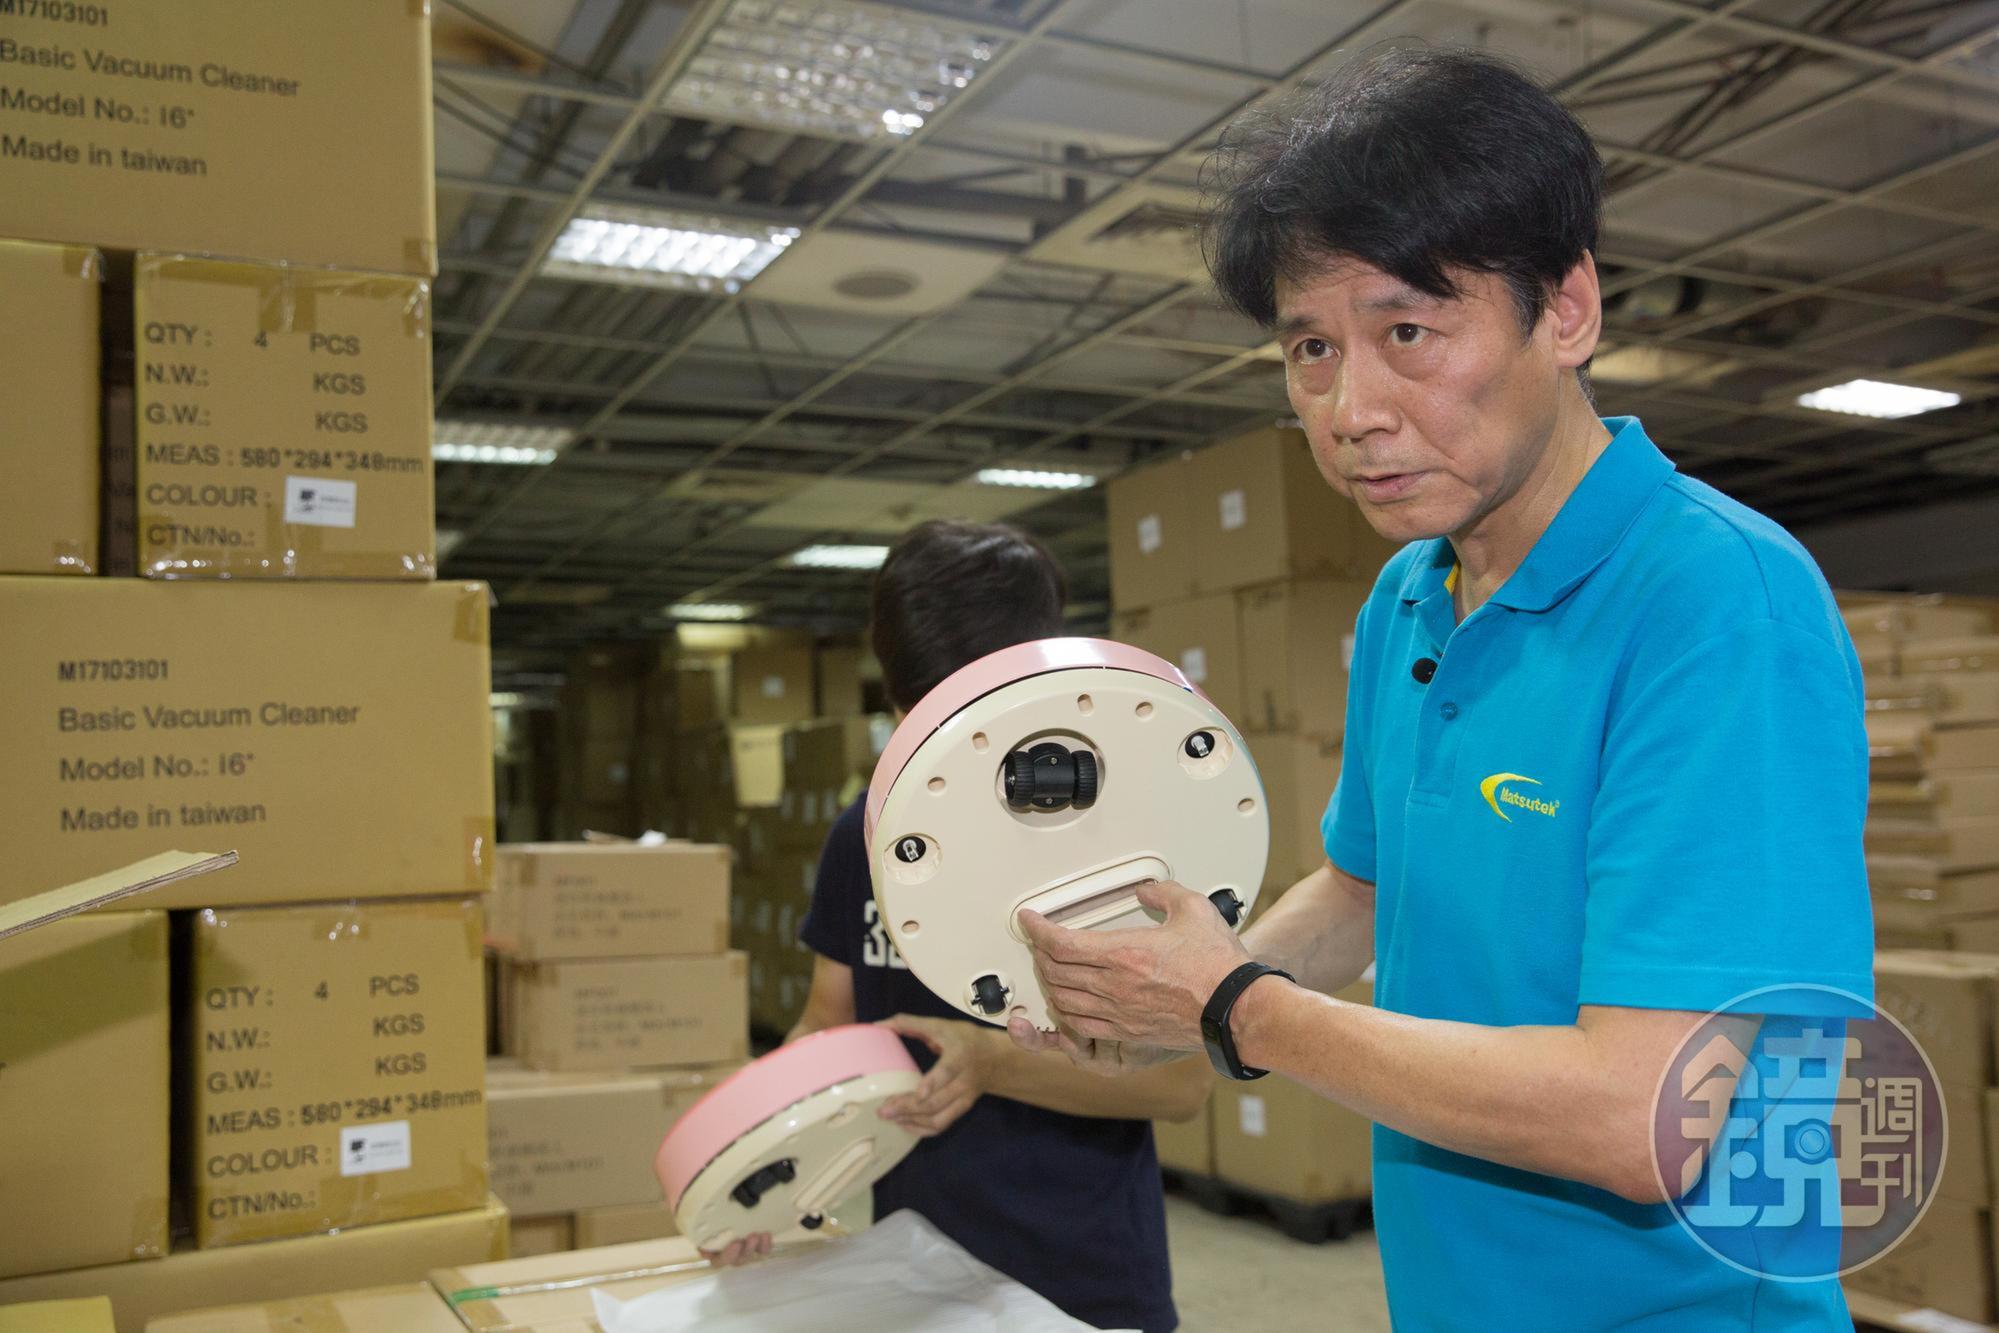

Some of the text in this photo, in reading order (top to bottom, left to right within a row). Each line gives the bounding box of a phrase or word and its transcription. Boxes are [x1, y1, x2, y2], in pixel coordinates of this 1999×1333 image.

[0, 38, 300, 96] Basic Vacuum Cleaner
[1, 87, 85, 118] Model
[2, 134, 207, 176] Made in taiwan
[253, 331, 268, 348] 4
[309, 333, 361, 356] PCS
[313, 373, 366, 395] KGS
[315, 411, 368, 433] KGS
[58, 659, 168, 682] M17103101
[58, 701, 361, 732] Basic Vacuum Cleaner
[59, 756, 144, 782] Model
[60, 800, 266, 832] Made in taiwan
[314, 980, 329, 1000] 4
[369, 973, 420, 997] PCS
[373, 1013, 425, 1037] KGS
[375, 1052, 427, 1077] KGS
